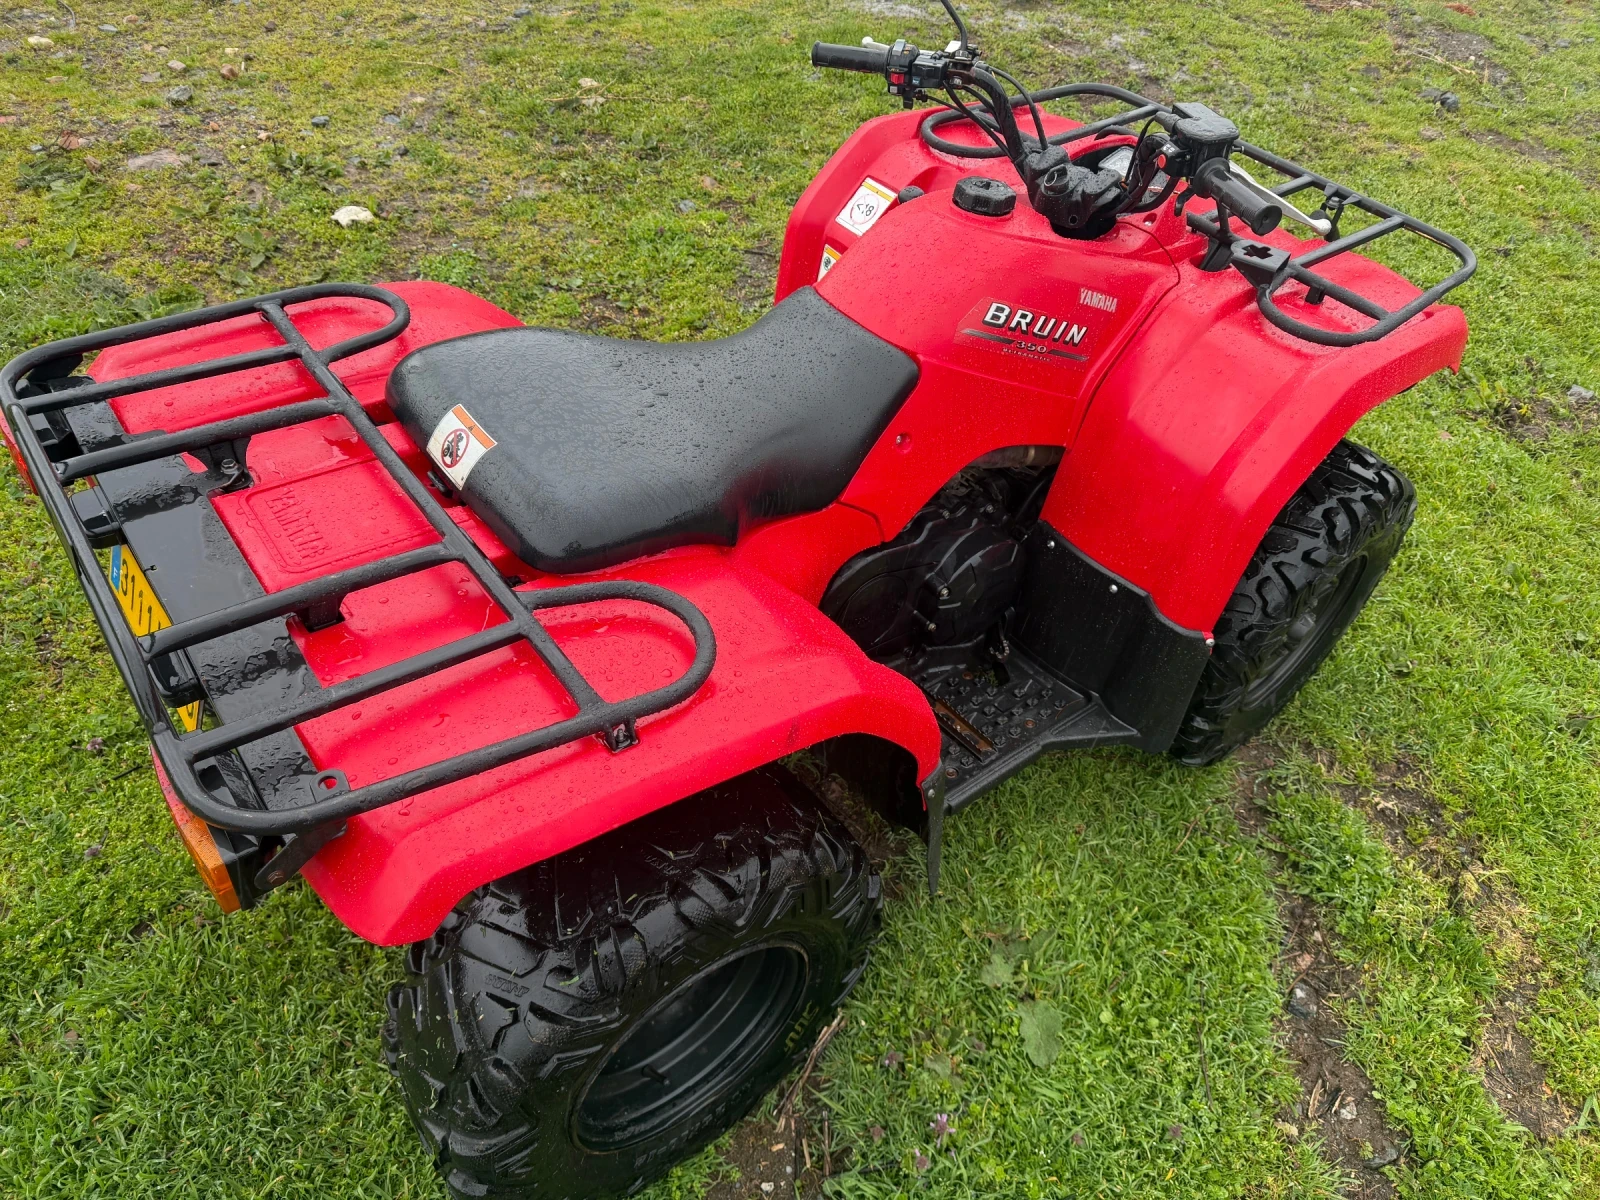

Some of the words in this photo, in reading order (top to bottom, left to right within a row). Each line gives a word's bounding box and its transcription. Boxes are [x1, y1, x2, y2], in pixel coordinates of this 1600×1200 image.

[1080, 287, 1118, 313] YAMAHA
[982, 302, 1088, 347] BRUIN
[1016, 340, 1047, 354] 350
